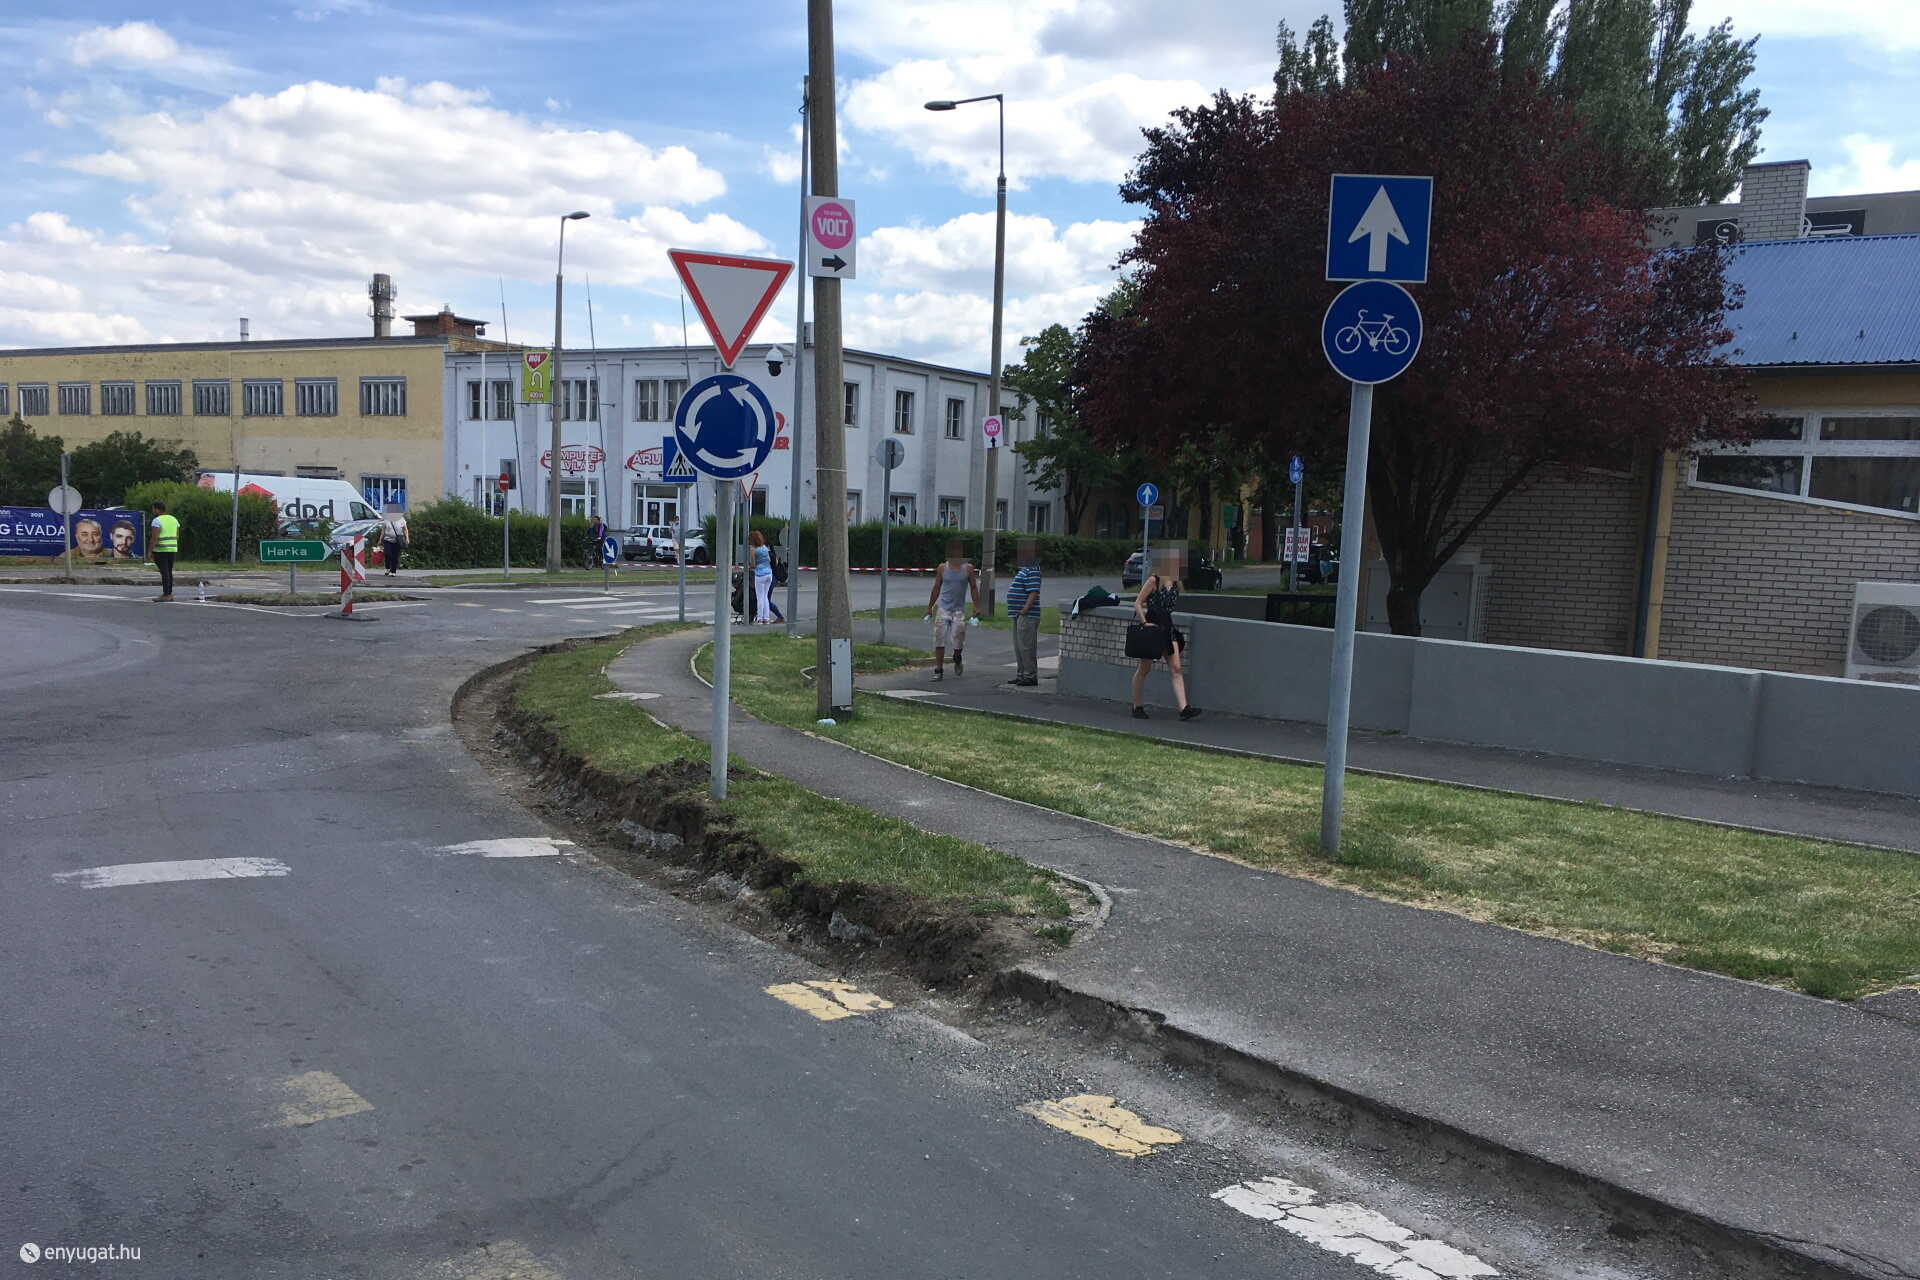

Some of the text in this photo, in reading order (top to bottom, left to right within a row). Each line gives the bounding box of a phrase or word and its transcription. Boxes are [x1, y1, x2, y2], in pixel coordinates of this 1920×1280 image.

[816, 216, 848, 237] VOLT
[544, 449, 605, 461] CMPUTER
[632, 450, 663, 465] ÁRU
[285, 497, 334, 520] dpd
[15, 521, 66, 536] ÉVADA
[267, 546, 307, 557] Harka
